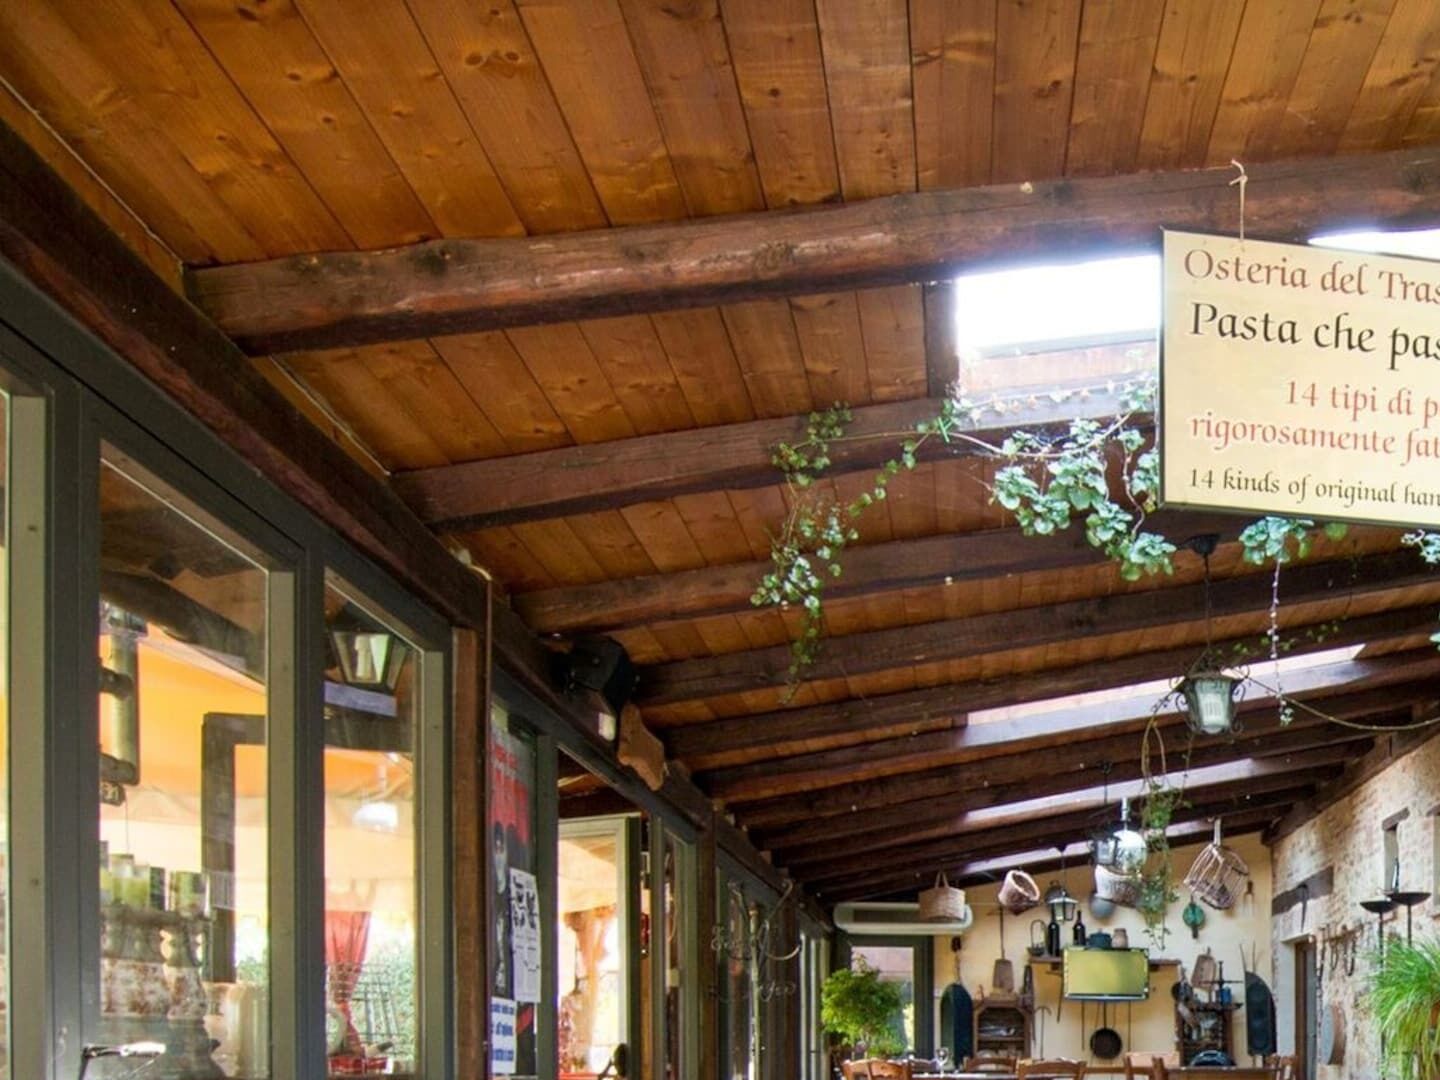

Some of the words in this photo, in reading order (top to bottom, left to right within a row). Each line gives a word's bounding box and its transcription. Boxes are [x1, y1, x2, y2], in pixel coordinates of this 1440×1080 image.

[1184, 249, 1310, 289] Osteria
[1320, 261, 1368, 296] del
[1189, 302, 1302, 345] Pasta
[1313, 312, 1376, 352] che
[1287, 381, 1319, 407] 14
[1330, 384, 1378, 422] tipi
[1387, 387, 1413, 416] di
[1191, 411, 1396, 455] rigorosamente
[1190, 468, 1215, 490] 14
[1223, 467, 1280, 494] kinds
[1288, 473, 1312, 505] of
[1315, 479, 1397, 509] original
